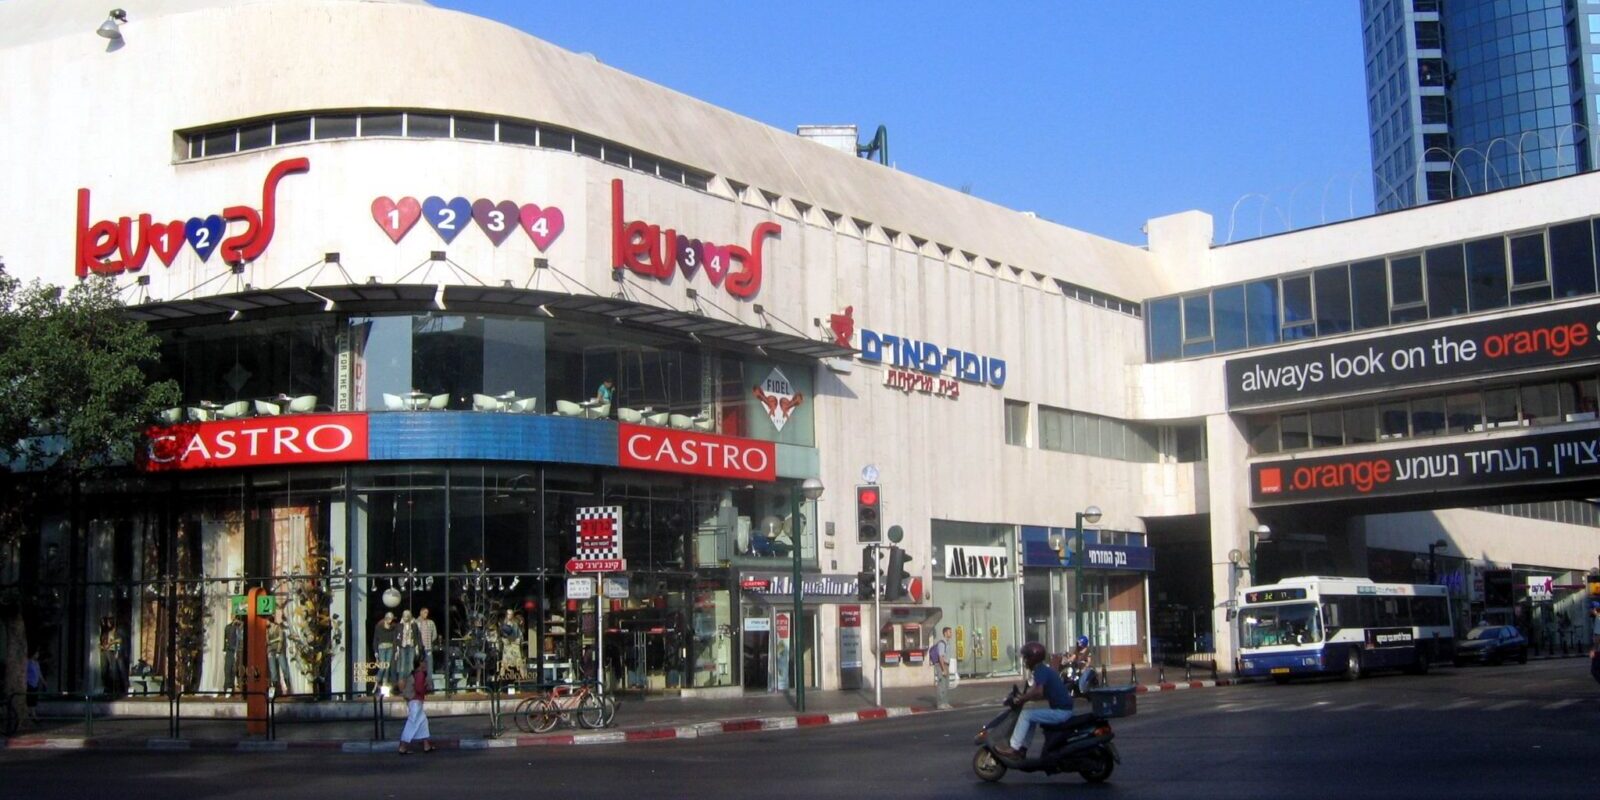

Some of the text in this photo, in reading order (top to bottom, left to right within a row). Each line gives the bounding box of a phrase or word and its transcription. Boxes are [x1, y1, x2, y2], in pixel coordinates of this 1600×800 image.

[387, 208, 549, 237] 1 2 3 4
[160, 234, 170, 253] 1
[195, 227, 210, 249] 2
[684, 247, 695, 266] 3
[710, 256, 721, 272] 4
[1242, 361, 1323, 391] always
[1331, 348, 1385, 379] look
[1391, 347, 1426, 372] on
[1432, 336, 1477, 365] the
[1484, 322, 1589, 357] orange
[767, 379, 790, 395] FIDEL
[628, 434, 767, 472] CASTRO
[1465, 446, 1538, 475] העתיד
[1396, 454, 1458, 482] נשמע
[950, 547, 1008, 577] Mayer
[262, 598, 270, 613] 2
